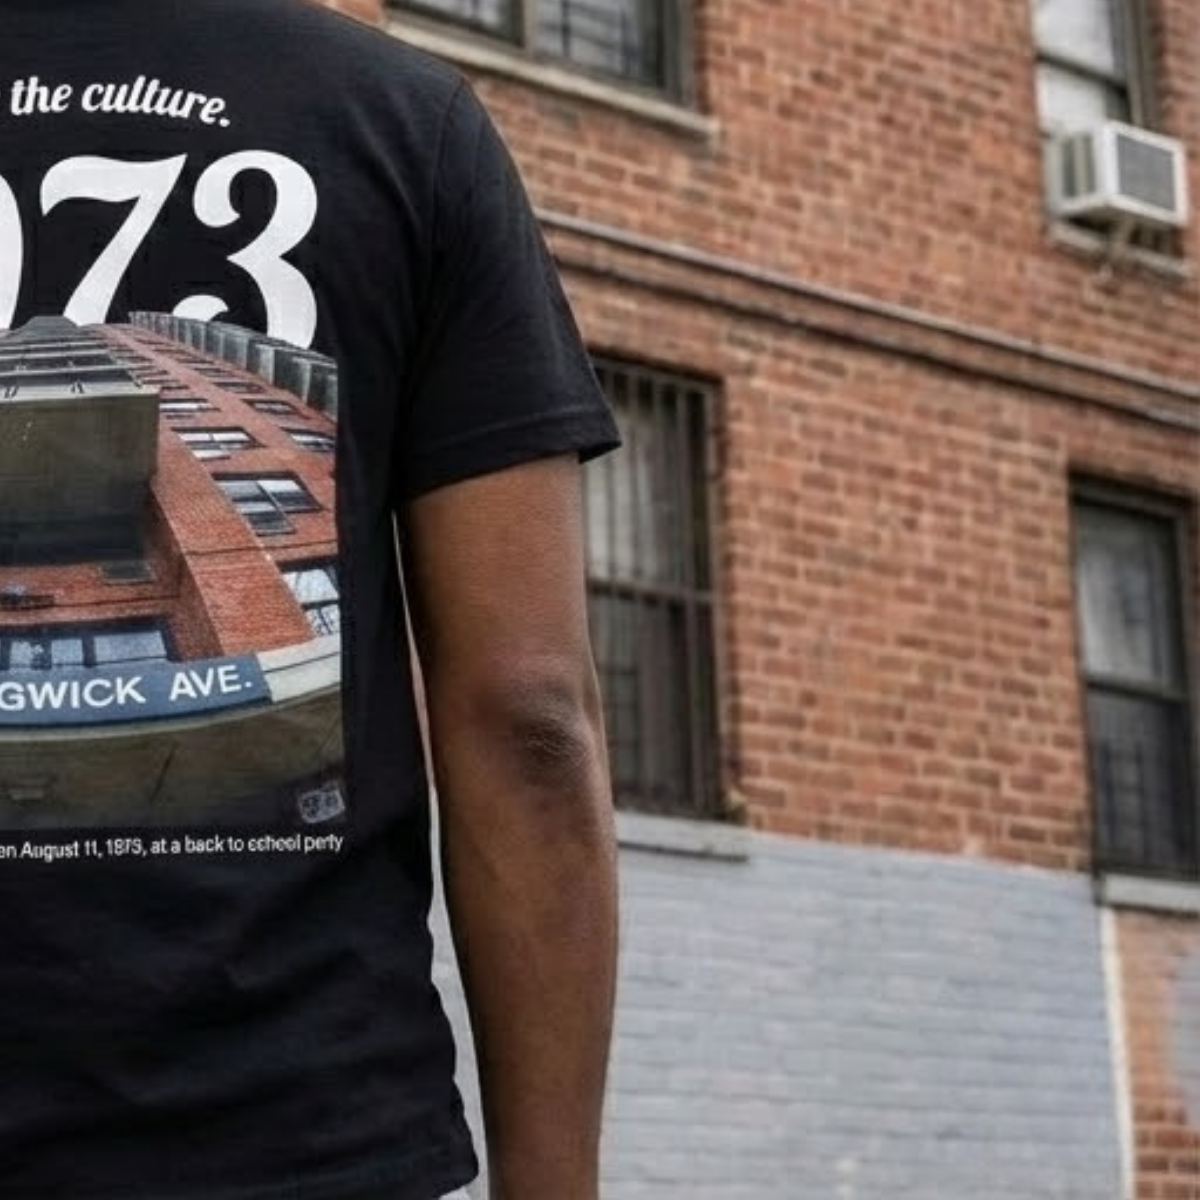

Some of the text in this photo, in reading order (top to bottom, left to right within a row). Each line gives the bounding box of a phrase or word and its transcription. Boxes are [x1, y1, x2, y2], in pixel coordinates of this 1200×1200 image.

[10, 75, 73, 116] the
[81, 74, 231, 128] culture.
[168, 664, 253, 702] AVE.
[19, 840, 79, 863] August
[150, 838, 168, 854] at
[170, 840, 181, 854] a
[184, 834, 224, 853] back
[227, 836, 244, 851] to
